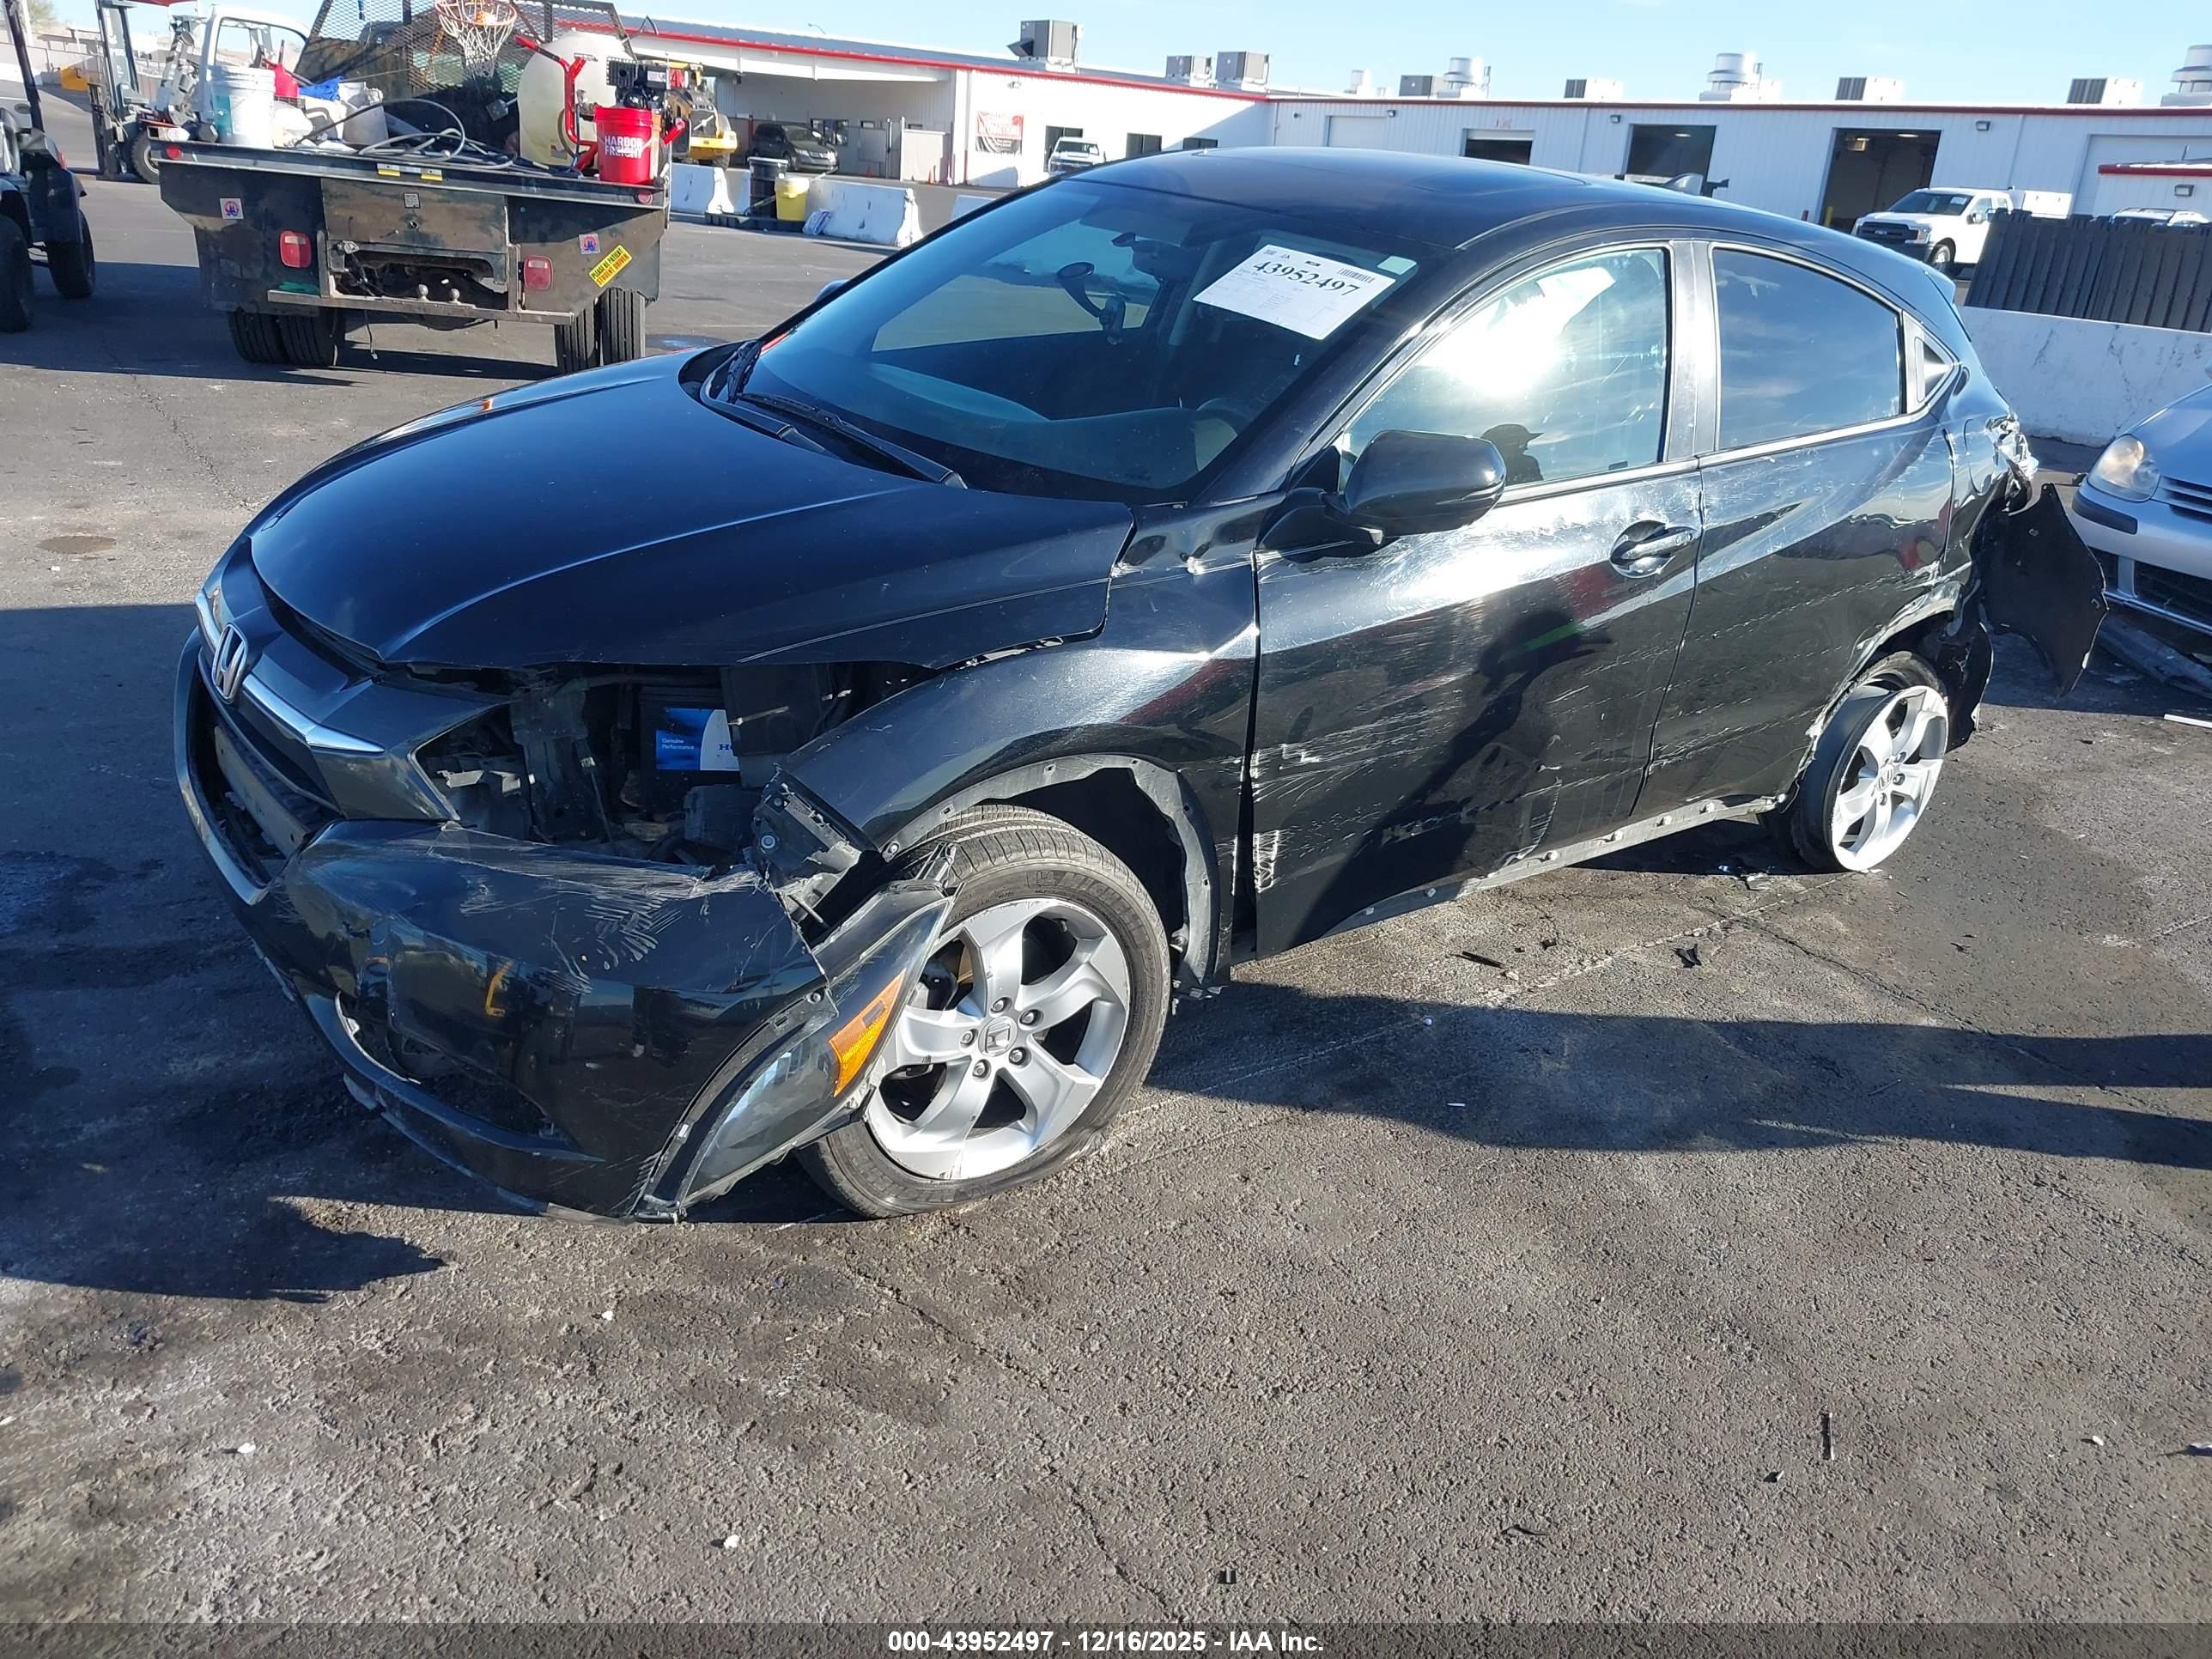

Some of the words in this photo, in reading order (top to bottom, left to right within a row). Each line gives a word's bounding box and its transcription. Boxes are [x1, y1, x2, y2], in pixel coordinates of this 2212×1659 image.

[604, 135, 643, 147] HARBOR
[1253, 261, 1360, 296] 43952497
[1057, 871, 1152, 949] MICHELIN
